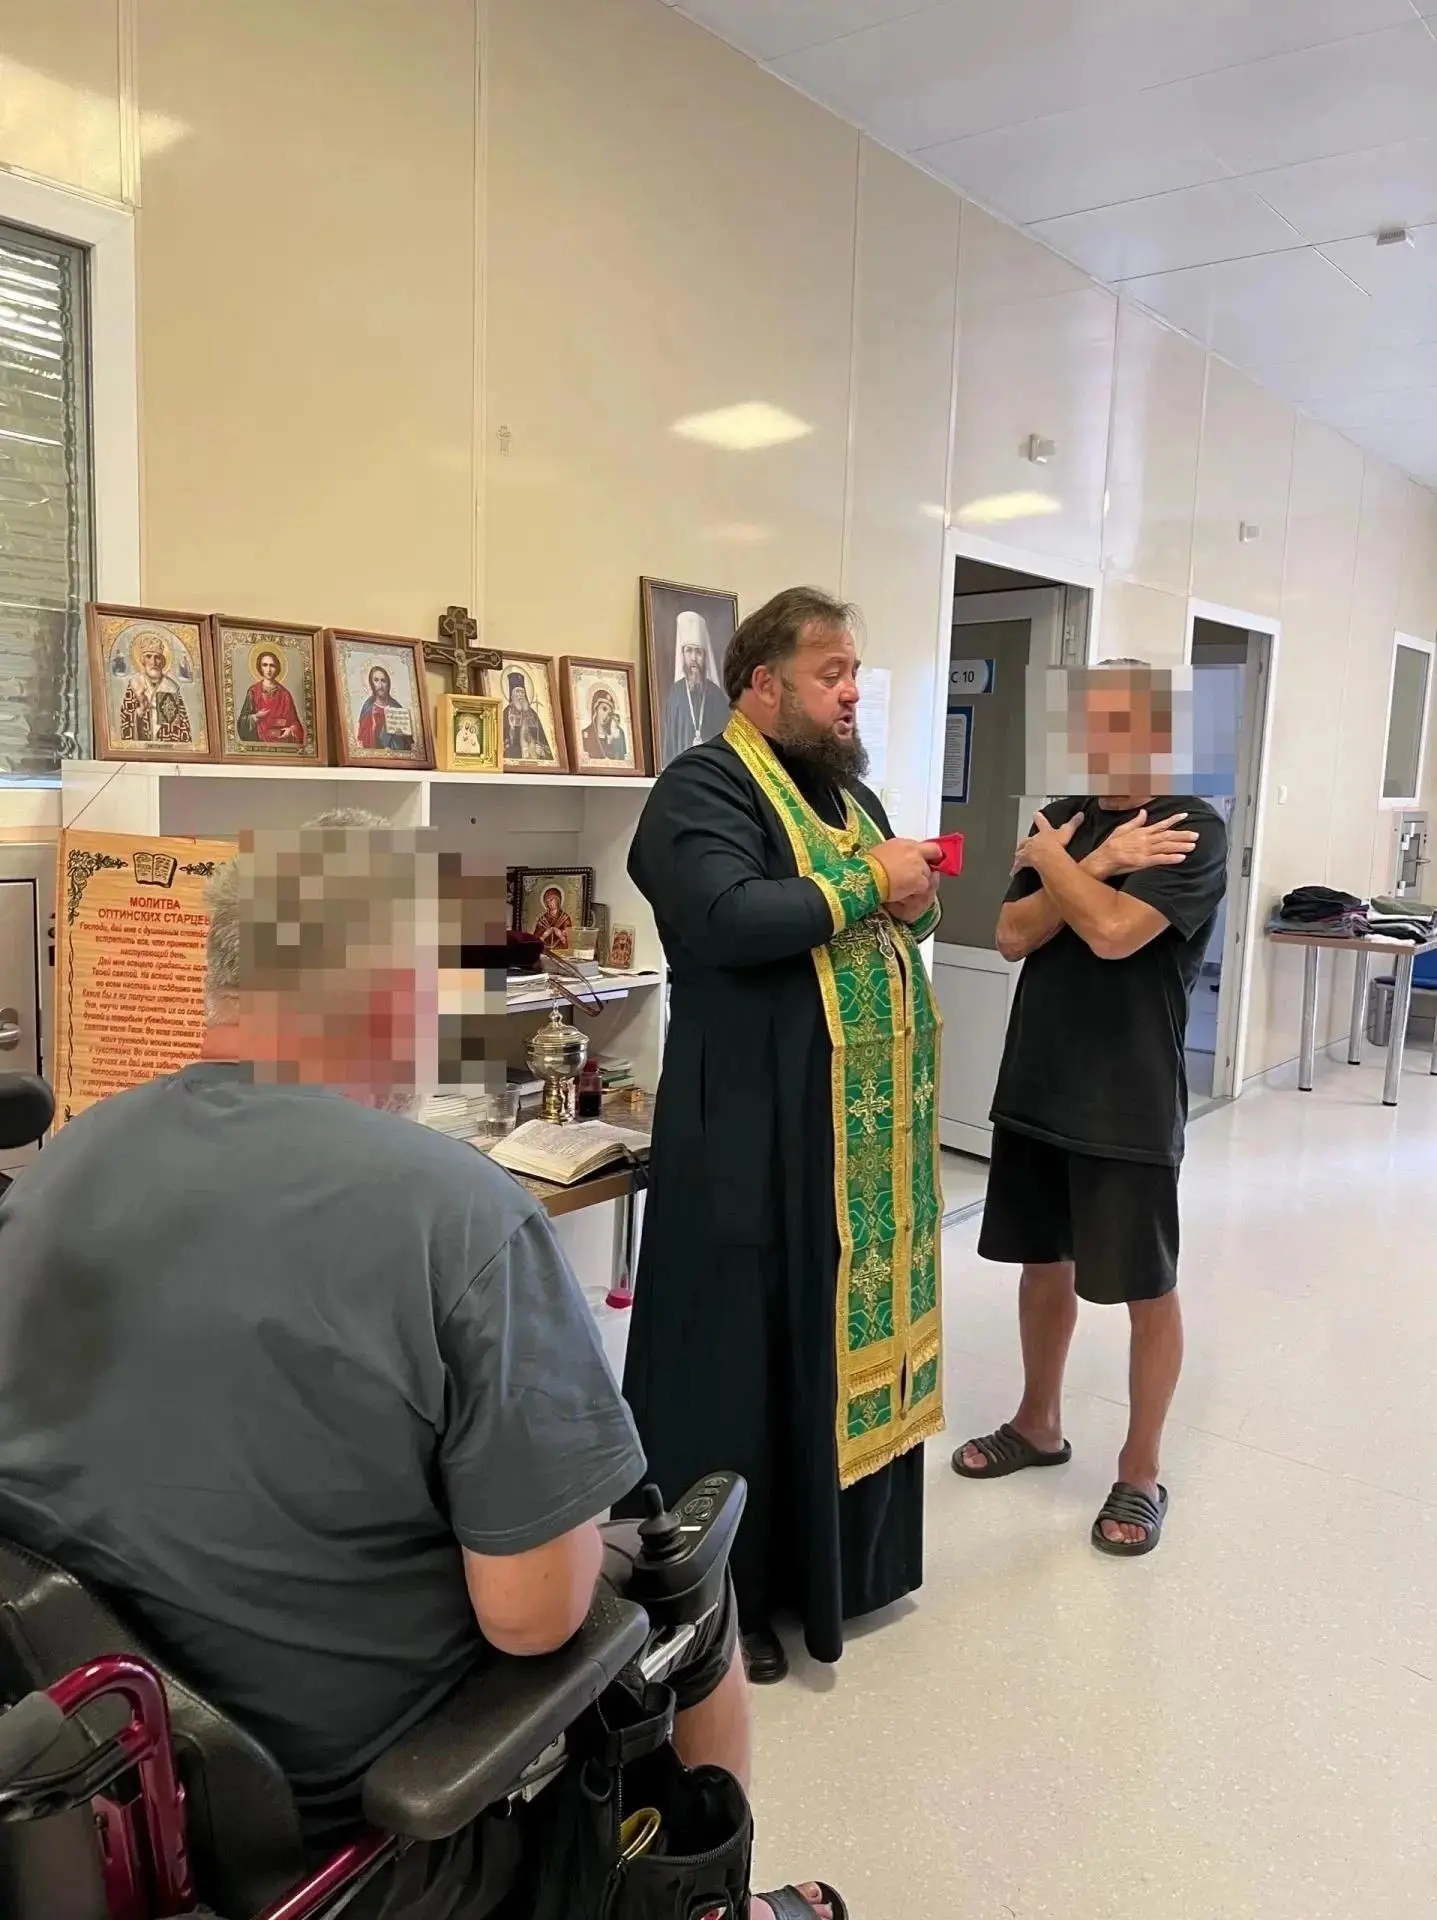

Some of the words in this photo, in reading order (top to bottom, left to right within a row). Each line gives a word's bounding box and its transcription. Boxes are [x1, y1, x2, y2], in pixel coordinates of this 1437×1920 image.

[962, 670, 975, 683] 10
[129, 896, 181, 910] МОЛИТВА
[98, 908, 161, 923] ОПТИНСКИХ
[79, 922, 109, 932] Господи,
[110, 923, 122, 933] дай
[95, 935, 135, 945] встретить
